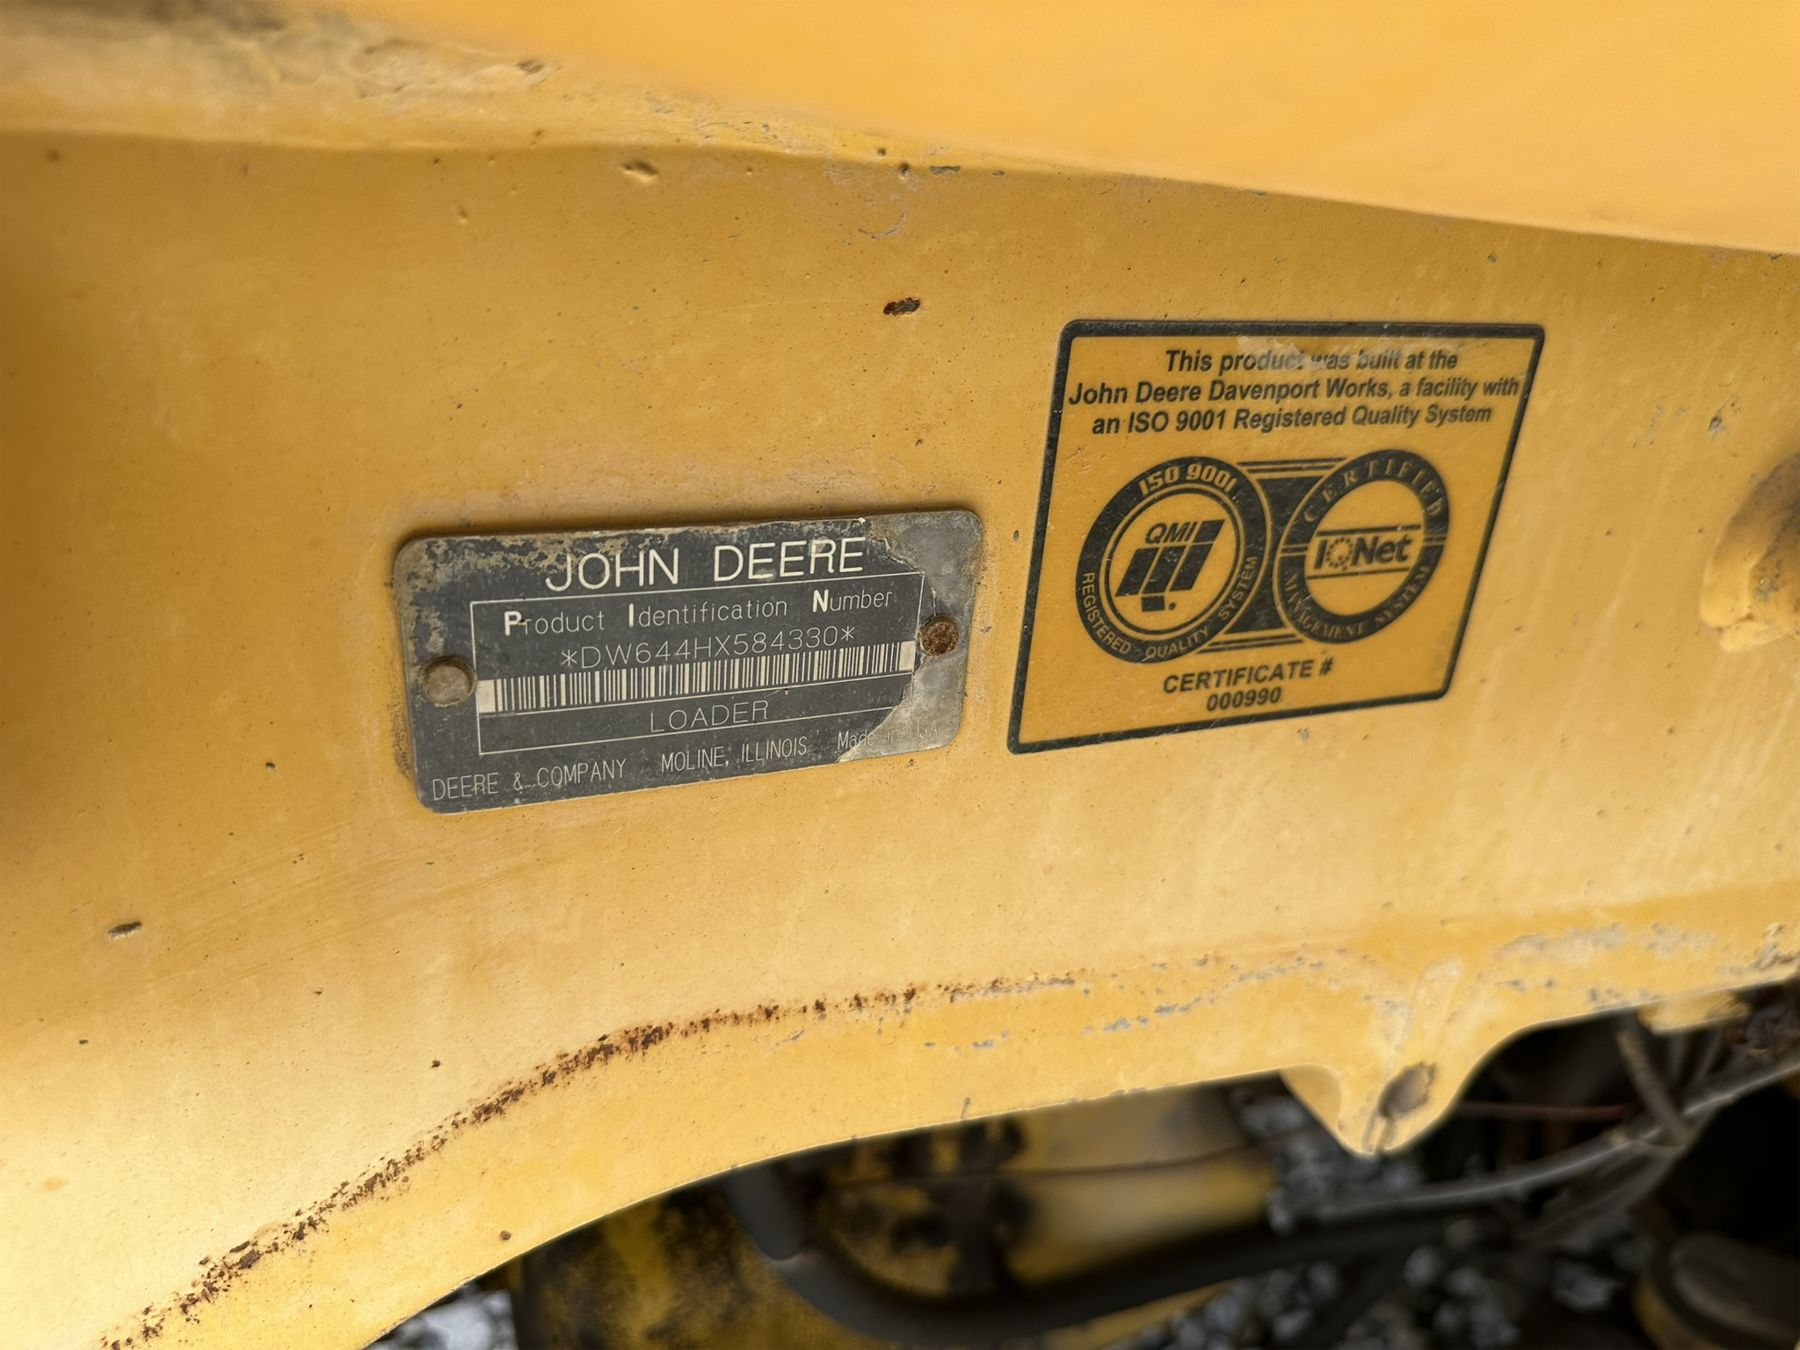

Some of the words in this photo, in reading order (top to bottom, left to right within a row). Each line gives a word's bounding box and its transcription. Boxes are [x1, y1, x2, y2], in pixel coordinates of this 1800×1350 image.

[1166, 350, 1212, 372] This
[1219, 350, 1304, 376] product
[1356, 349, 1401, 369] built
[1404, 351, 1424, 369] at
[1428, 350, 1458, 369] the
[1068, 382, 1128, 405] John
[1136, 381, 1201, 403] Deere
[1208, 379, 1320, 404] Davenport
[1326, 378, 1393, 399] Works,
[1399, 382, 1411, 396] a
[1416, 377, 1478, 400] facility
[1483, 377, 1520, 396] with
[1092, 417, 1120, 434] an
[1128, 411, 1169, 433] ISO
[1176, 409, 1226, 431] 9001
[1234, 406, 1347, 433] Registered
[1352, 404, 1420, 428] Quality
[1424, 403, 1492, 427] System
[1138, 466, 1180, 496] ISO
[1186, 463, 1238, 492] 9001
[1303, 458, 1444, 522] CERTIFIED
[1145, 521, 1198, 544] QMI
[546, 548, 679, 592] JOHN
[713, 536, 866, 582] DEERE
[504, 610, 605, 637] Product
[628, 599, 788, 630] Identification
[812, 590, 893, 614] Number
[1081, 571, 1133, 656] REGISTERED
[1145, 625, 1212, 659] QUALITY
[1217, 555, 1259, 621] SYSTEM
[1163, 660, 1314, 694] CERTIFICATE
[1318, 657, 1334, 676] #
[650, 699, 769, 733] LOADER
[1206, 687, 1282, 711] 000990
[432, 772, 499, 800] DEERE
[513, 772, 524, 791] &
[537, 758, 627, 788] COMPANY
[661, 745, 730, 773] MOLINE,
[741, 736, 808, 763] ILLINOIS
